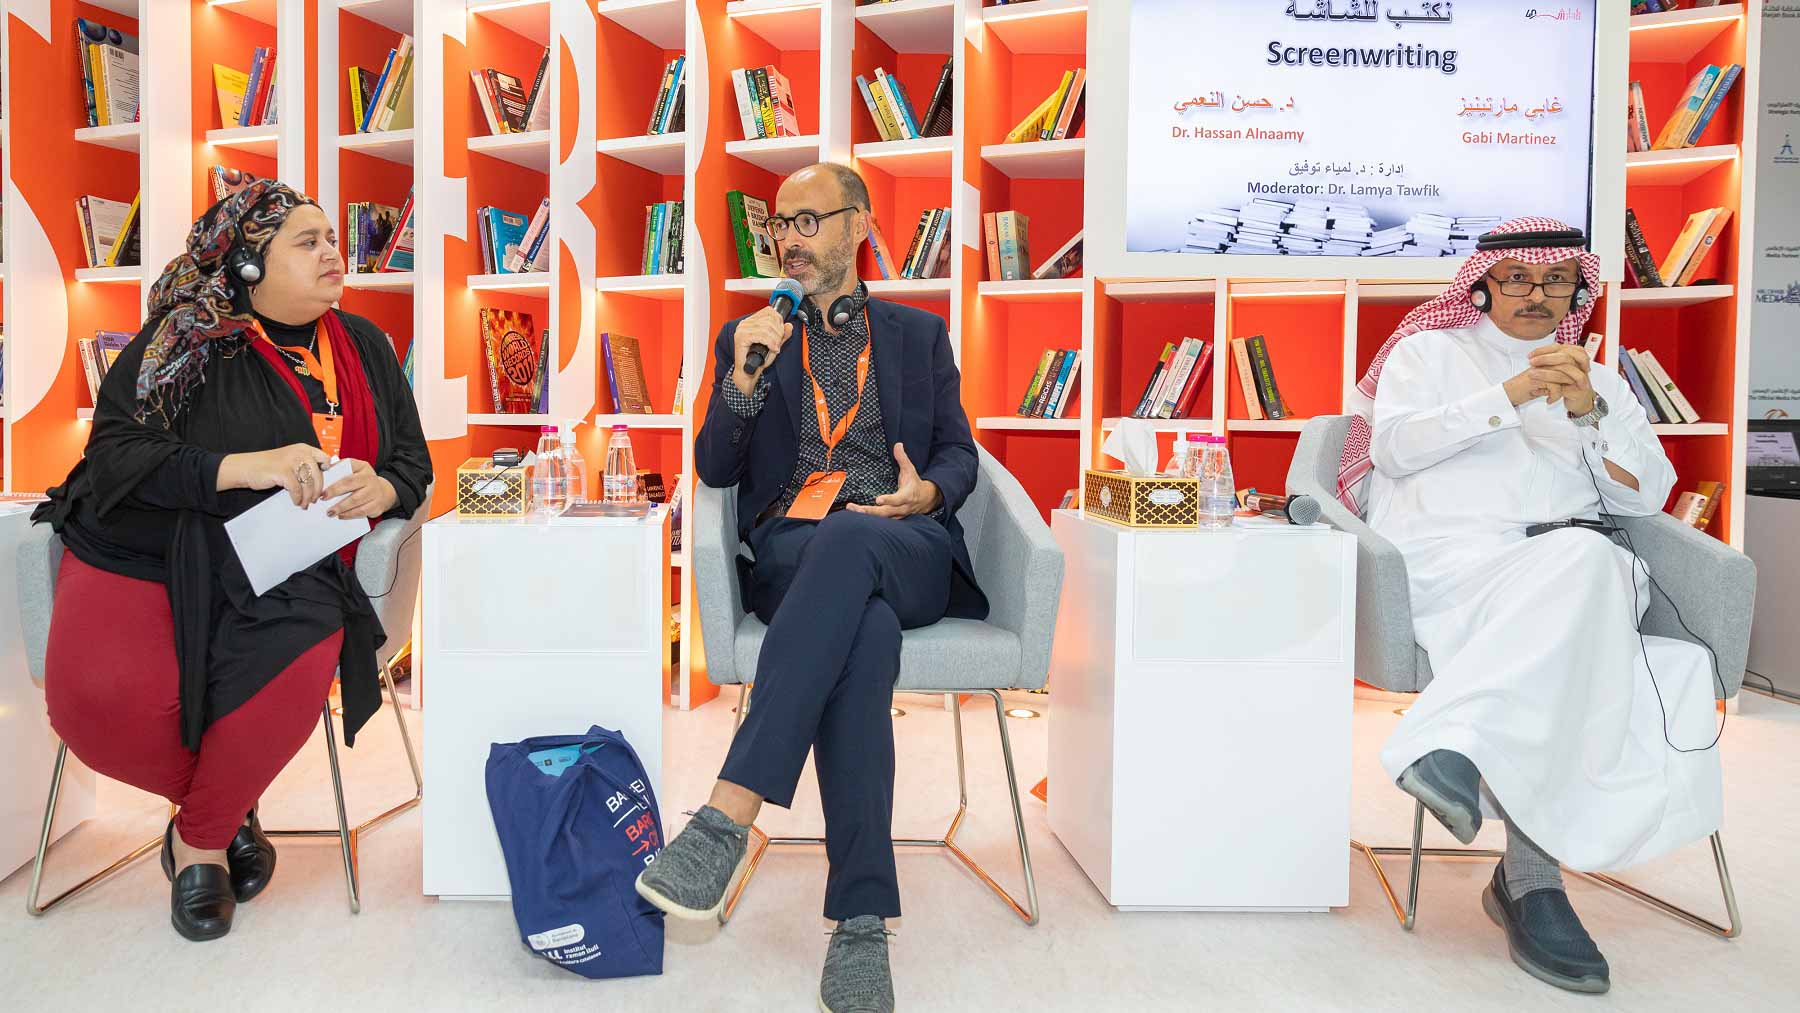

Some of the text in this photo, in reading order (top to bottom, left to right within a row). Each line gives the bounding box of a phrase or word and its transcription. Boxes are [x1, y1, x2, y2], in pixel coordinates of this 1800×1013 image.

[1386, 1, 1453, 29] نكتب
[1267, 41, 1458, 74] Screenwriting
[1173, 91, 1225, 115] النعمي
[1232, 95, 1274, 114] حسن
[1457, 96, 1564, 119] غابي مارتينيز
[1171, 126, 1305, 144] Dr. Hassan Alnaamy
[1462, 131, 1557, 145] Gabi Martinez
[1288, 160, 1321, 177] توفيق
[1325, 162, 1352, 176] لمياء
[1247, 181, 1440, 199] Moderator: Dr. Lamya Tawfik
[502, 341, 528, 360] WORLD
[504, 349, 530, 369] RECORDS
[507, 355, 534, 383] 2011
[1039, 380, 1052, 404] REICHS
